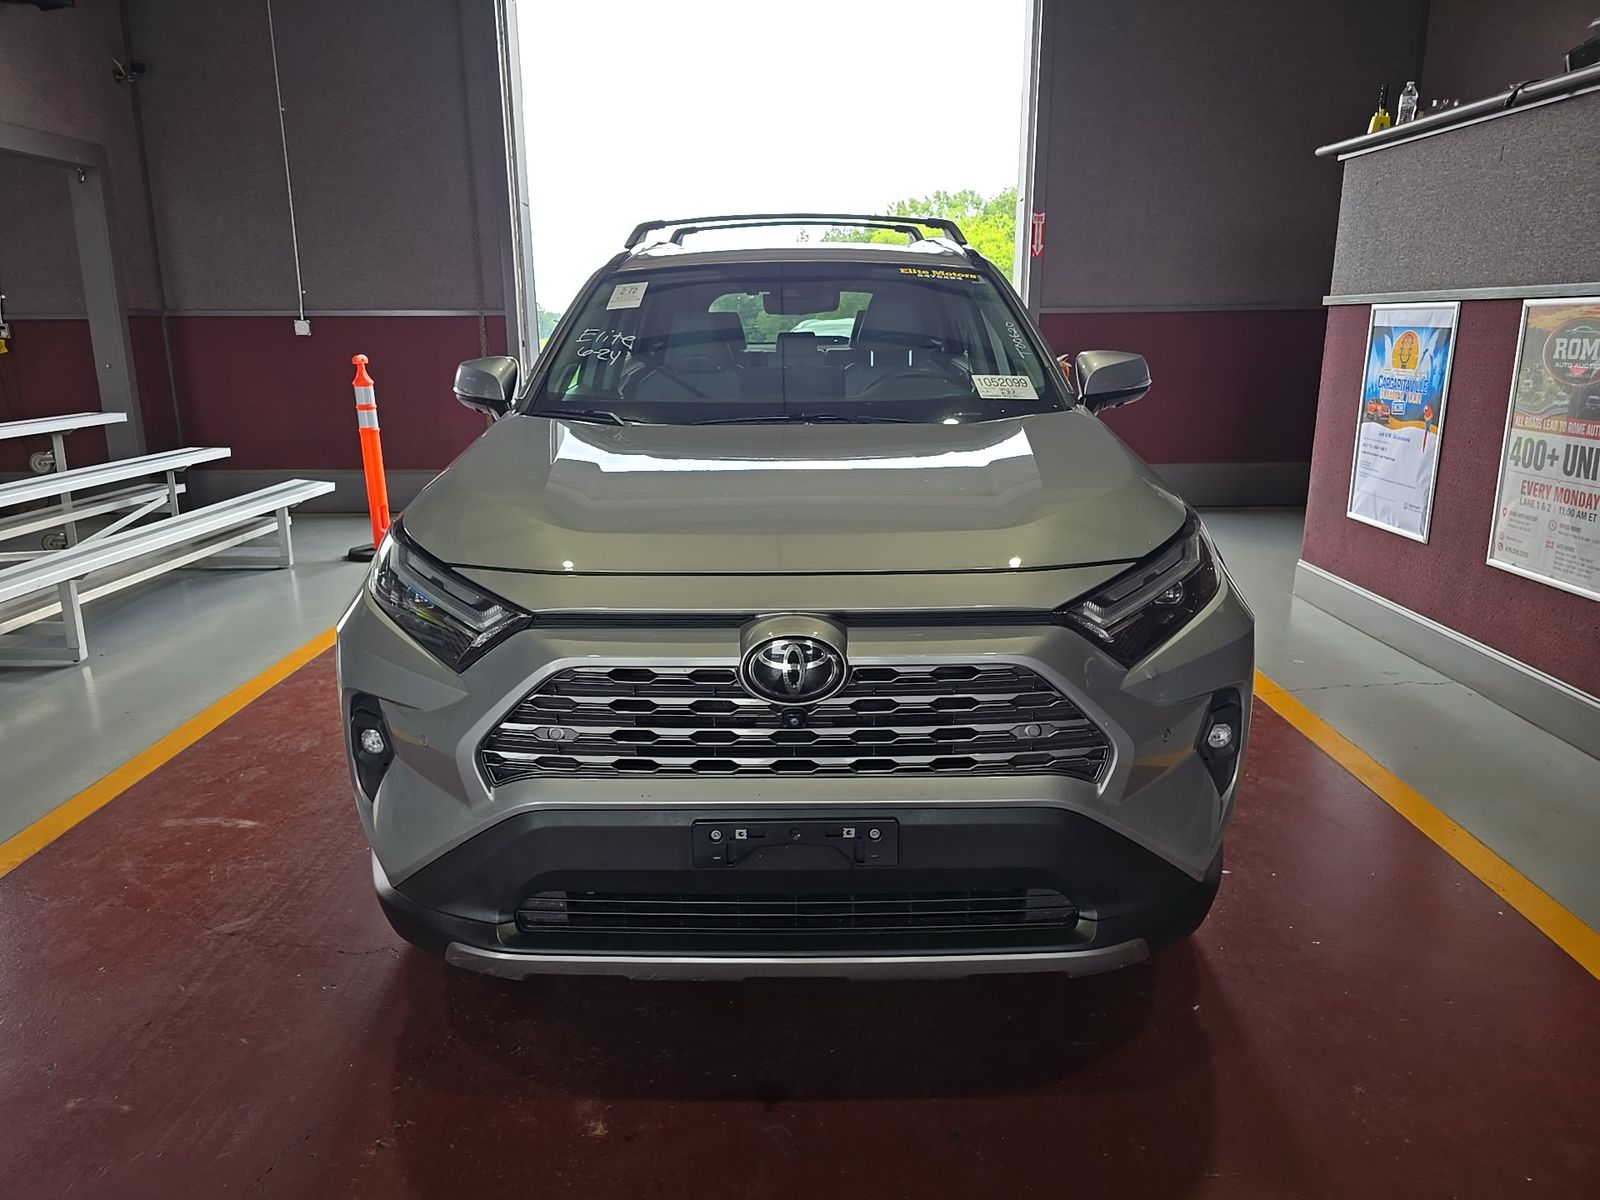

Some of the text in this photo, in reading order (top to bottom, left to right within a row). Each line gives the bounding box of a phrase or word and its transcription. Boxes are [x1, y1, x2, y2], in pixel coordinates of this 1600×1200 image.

[931, 270, 977, 279] Motors
[576, 328, 636, 349] Elite
[1553, 337, 1600, 361] ROM
[1573, 362, 1600, 370] AUCTIO
[977, 377, 1028, 388] 1052099
[1543, 418, 1559, 431] LEAD
[1559, 420, 1568, 432] TO
[1568, 421, 1587, 435] ROME
[1587, 423, 1600, 437] AUT
[1510, 436, 1600, 481] 400+ UNI
[1521, 480, 1600, 511] EVERY MONDAY
[1520, 497, 1535, 509] LANE
[1558, 506, 1575, 518] 11:00
[1576, 510, 1588, 521] AM
[1588, 513, 1598, 523] ET
